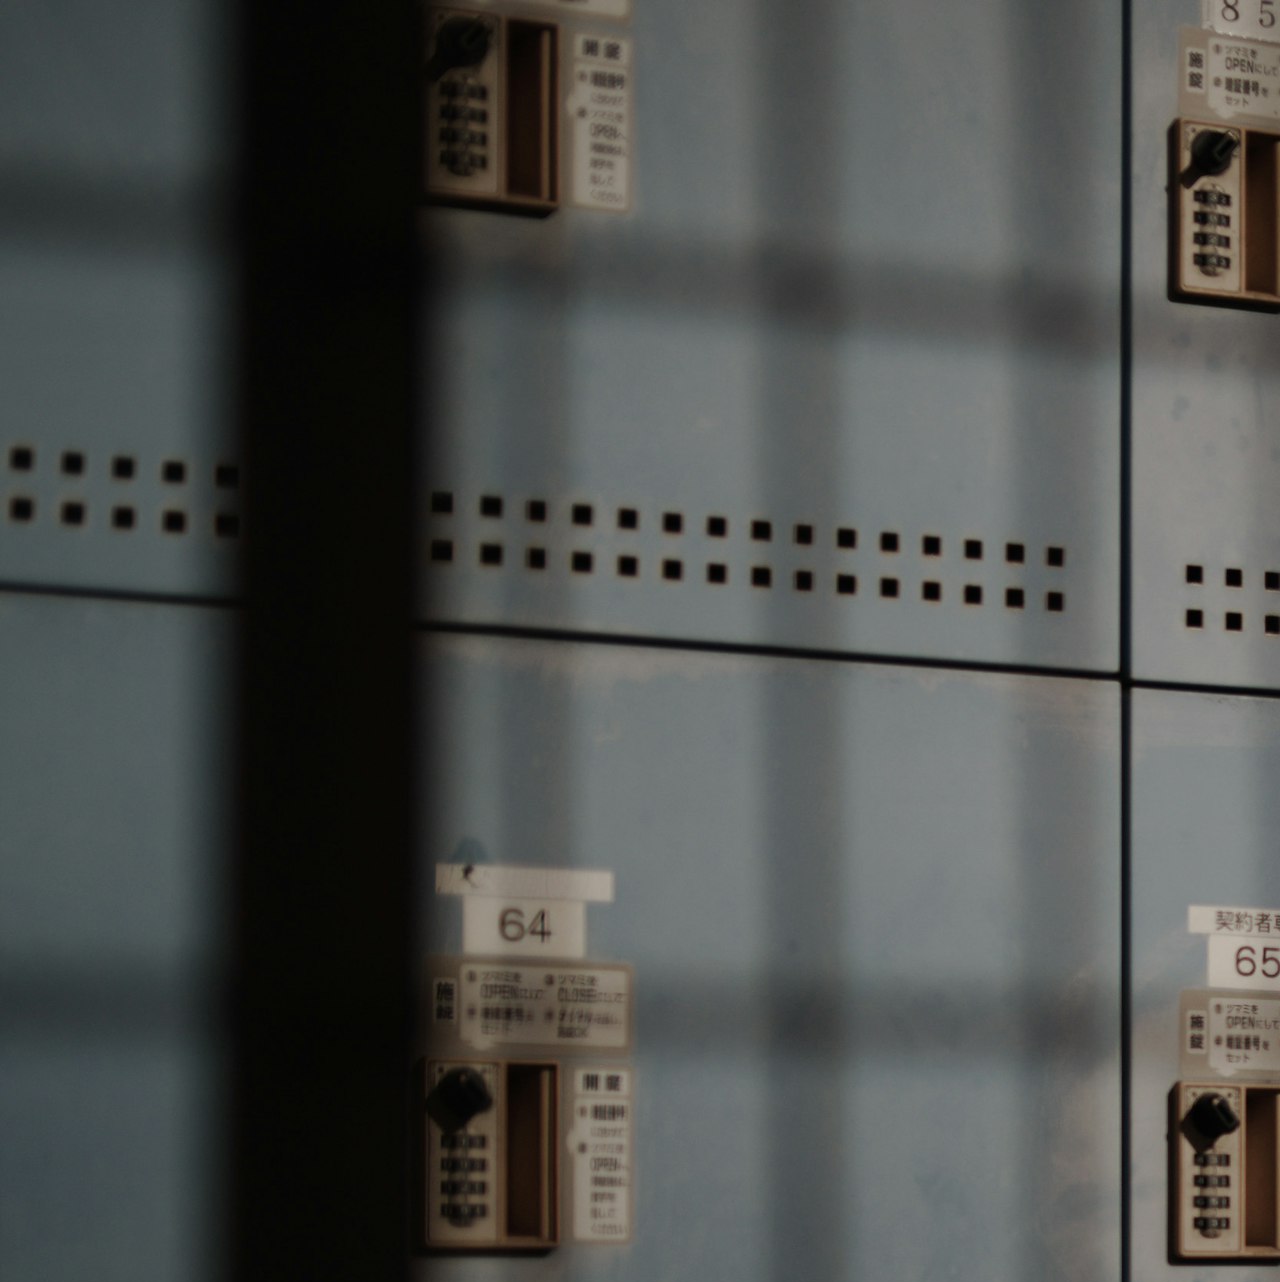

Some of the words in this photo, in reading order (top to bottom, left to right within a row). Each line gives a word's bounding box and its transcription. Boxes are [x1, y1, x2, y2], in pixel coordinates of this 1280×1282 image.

[1222, 0, 1275, 28] 85
[499, 908, 551, 943] 64
[1236, 946, 1280, 978] 65
